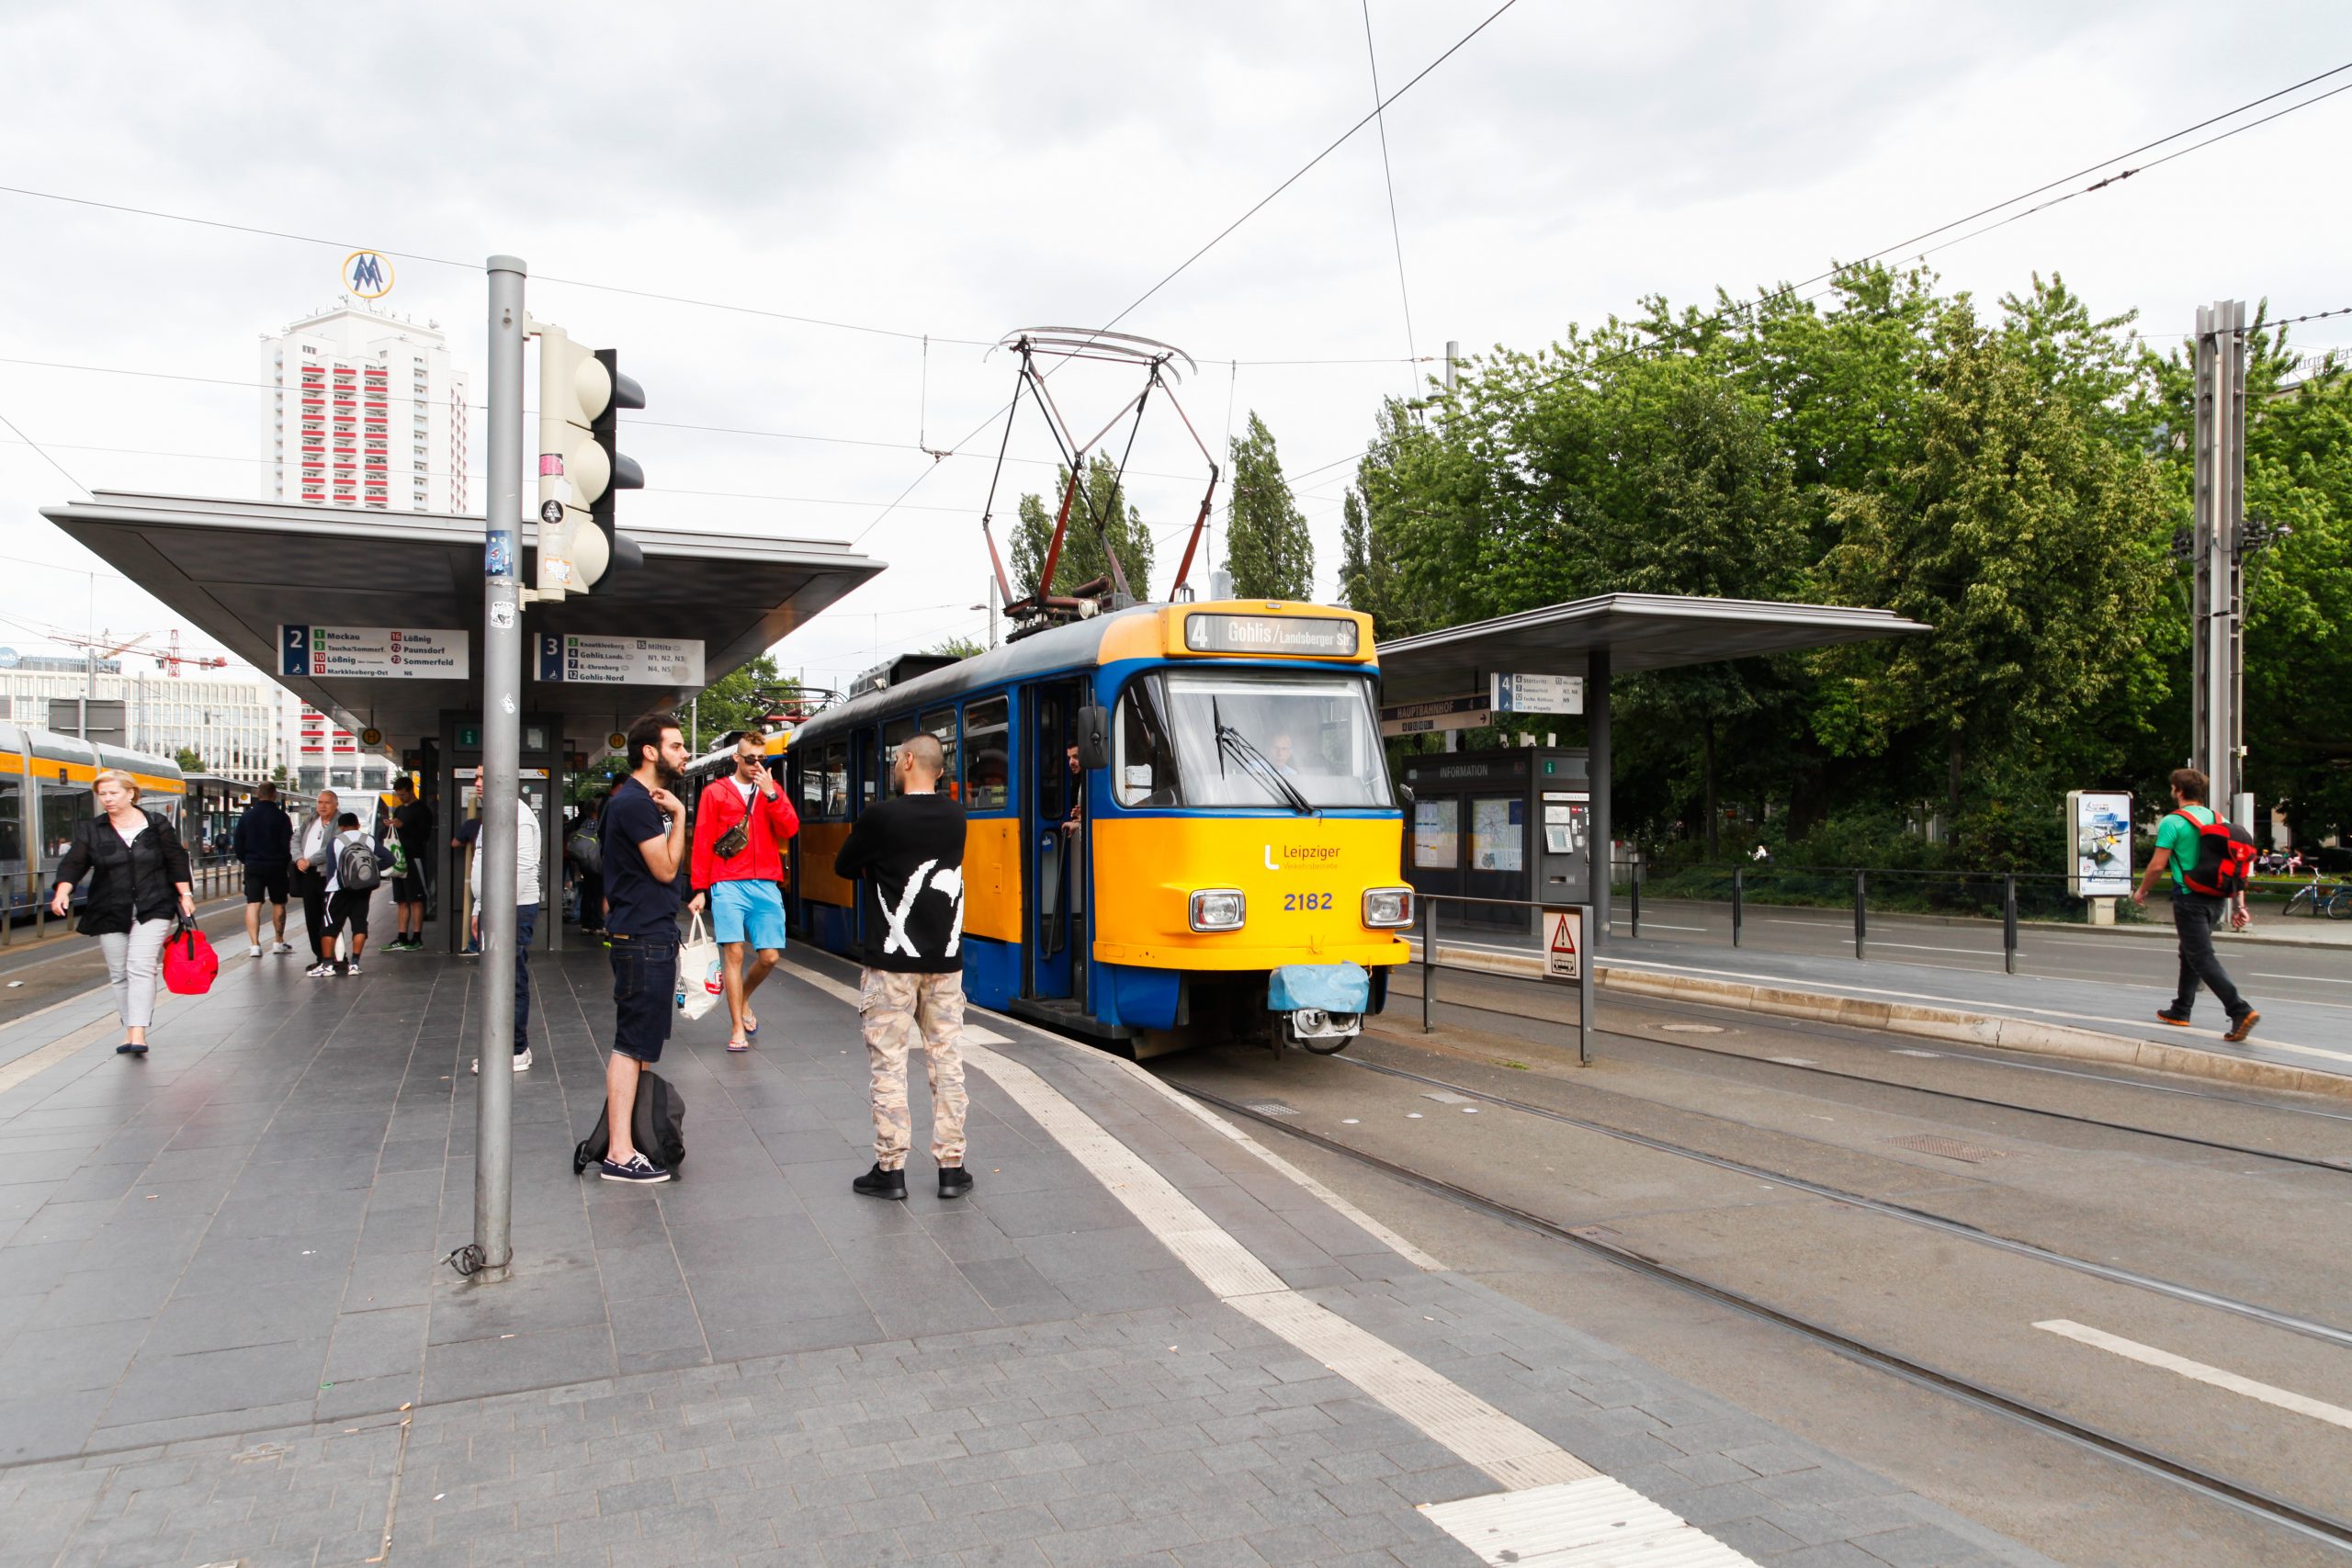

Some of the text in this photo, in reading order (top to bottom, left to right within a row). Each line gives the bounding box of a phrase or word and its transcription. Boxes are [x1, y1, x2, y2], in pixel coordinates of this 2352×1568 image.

[1192, 616, 1208, 648] 4
[289, 630, 302, 649] 2
[316, 641, 322, 649] 3
[403, 635, 432, 644] Lößnig
[580, 642, 625, 650] Knautkleeberg
[1337, 633, 1353, 646] Str.
[404, 646, 445, 654] Paunsdorf
[547, 638, 558, 655] 3
[315, 653, 324, 661] 10
[327, 656, 356, 665] Lößnig
[404, 658, 454, 666] Sommerfeld
[580, 673, 625, 682] Gohlis-Nord
[1502, 677, 1510, 690] 4
[1396, 701, 1454, 719] HAUPTBAHNHOF
[1440, 763, 1488, 779] INFORMATION
[1283, 844, 1340, 861] Leipziger
[1283, 893, 1332, 911] 2182
